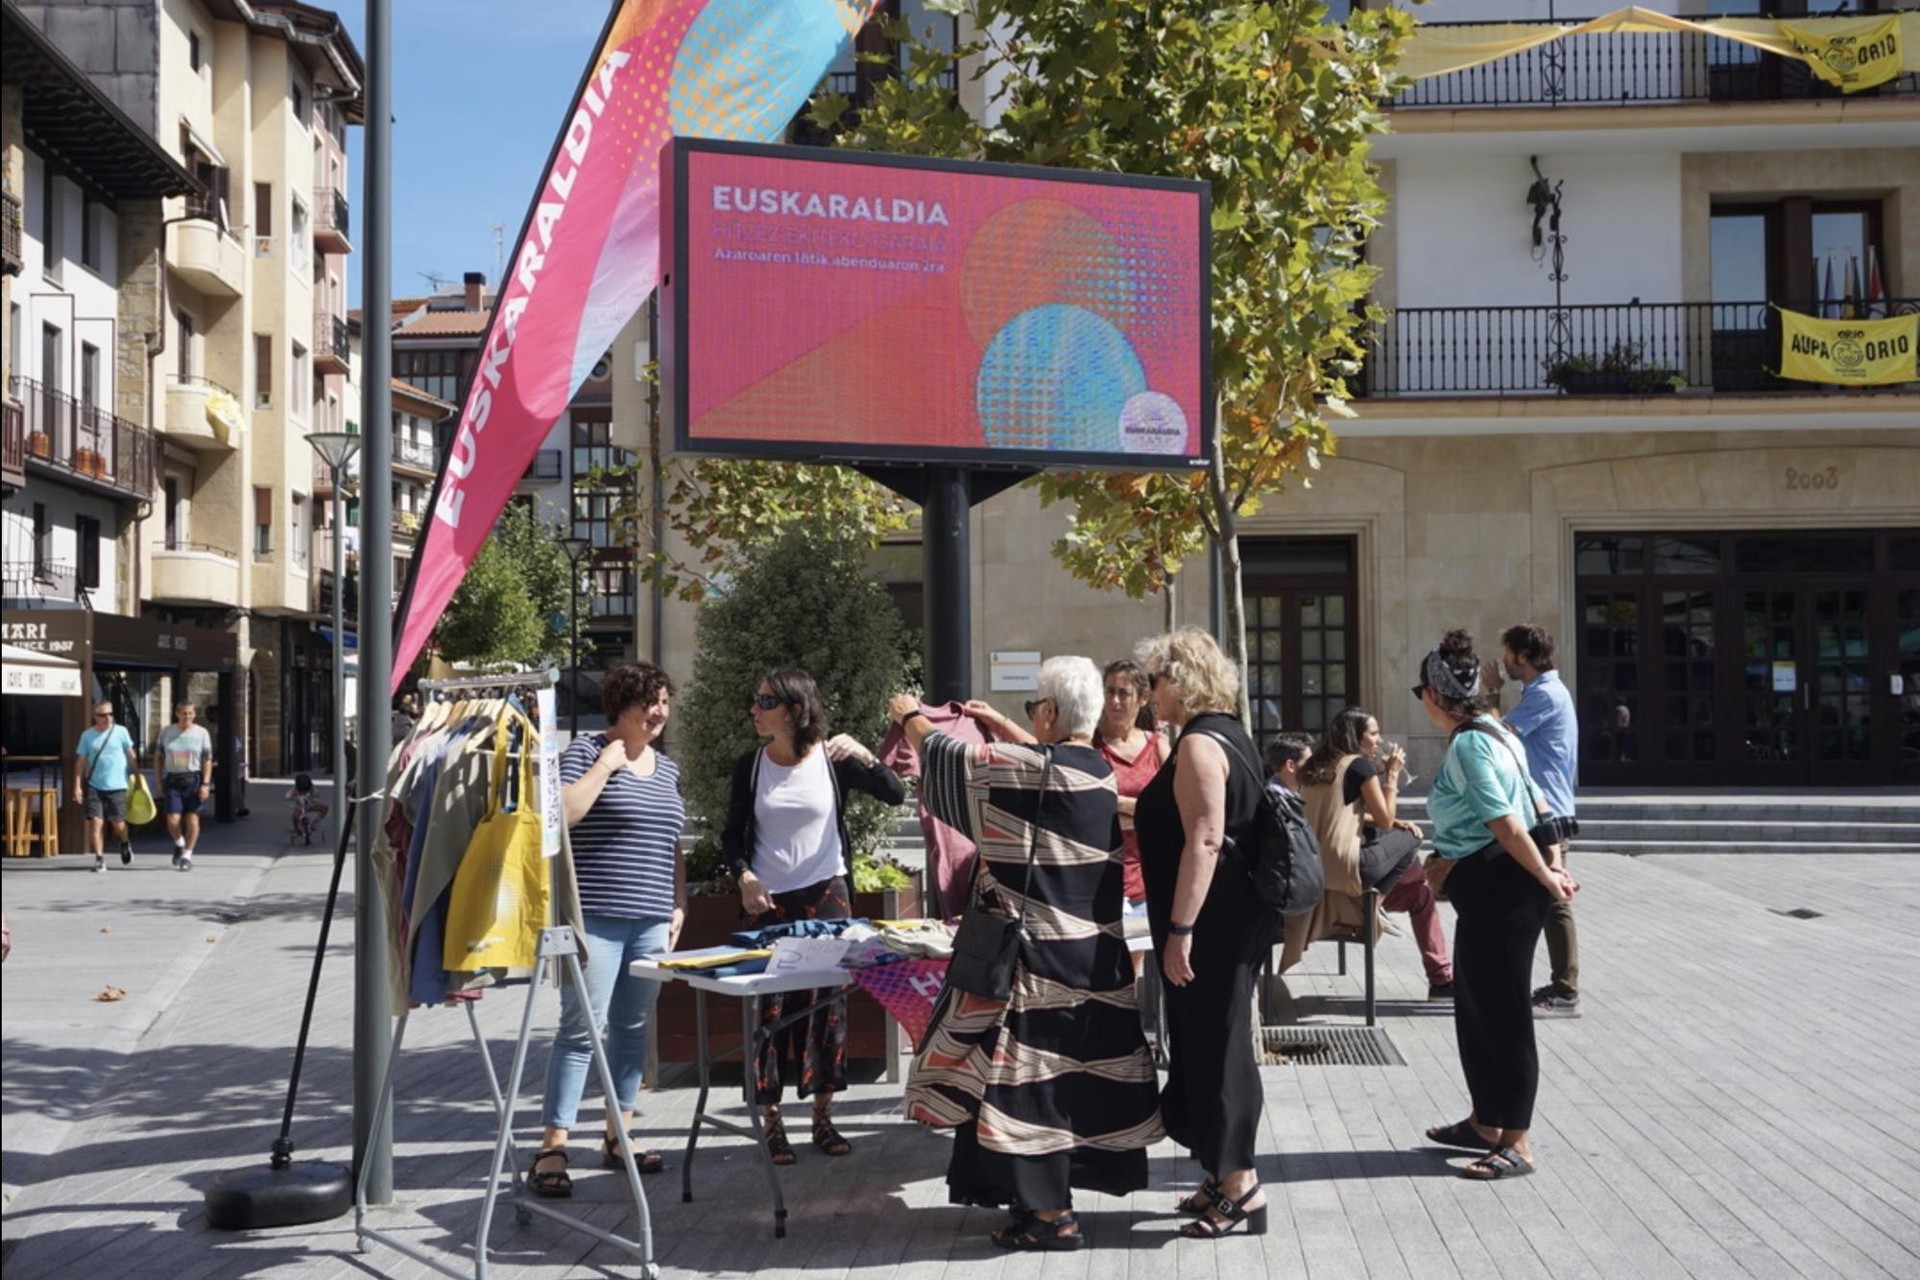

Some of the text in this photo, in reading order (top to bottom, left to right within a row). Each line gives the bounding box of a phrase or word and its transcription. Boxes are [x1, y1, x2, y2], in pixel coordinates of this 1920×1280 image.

[1857, 33, 1897, 65] ORIO
[712, 185, 949, 226] EUSKARALDIA
[434, 48, 631, 529] EUSKARALDIA
[1790, 333, 1909, 361] AUPA ORIO
[1785, 466, 1838, 491] 2003
